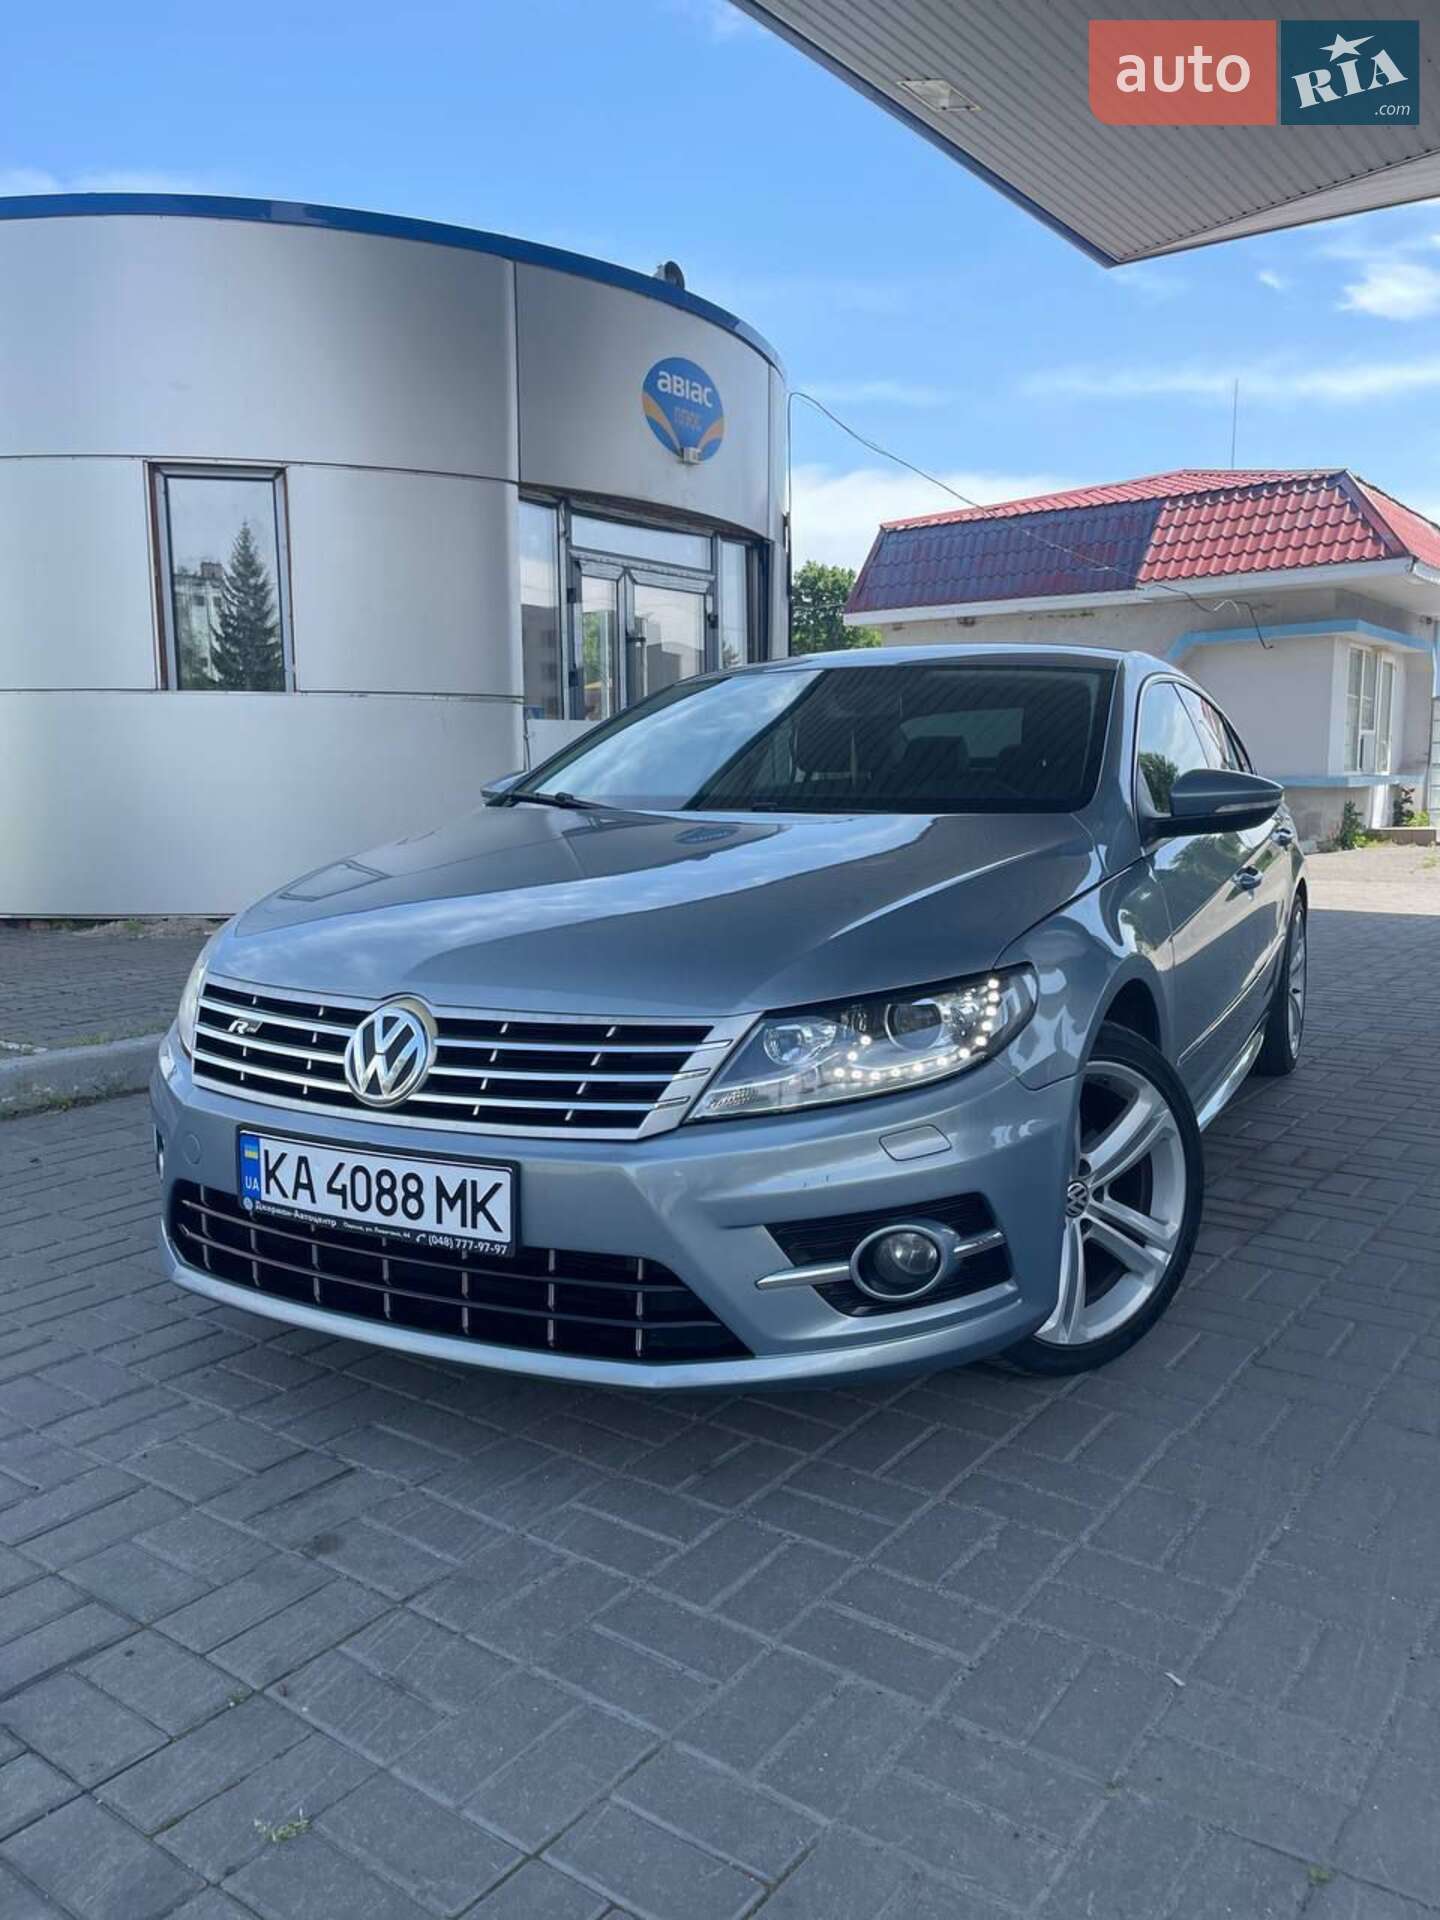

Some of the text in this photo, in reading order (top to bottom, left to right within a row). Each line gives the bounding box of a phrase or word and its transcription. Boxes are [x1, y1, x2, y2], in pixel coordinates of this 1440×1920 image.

[245, 1176, 261, 1192] UA
[264, 1149, 504, 1233] KA 4088 MK
[455, 1238, 508, 1255] 777-97-97
